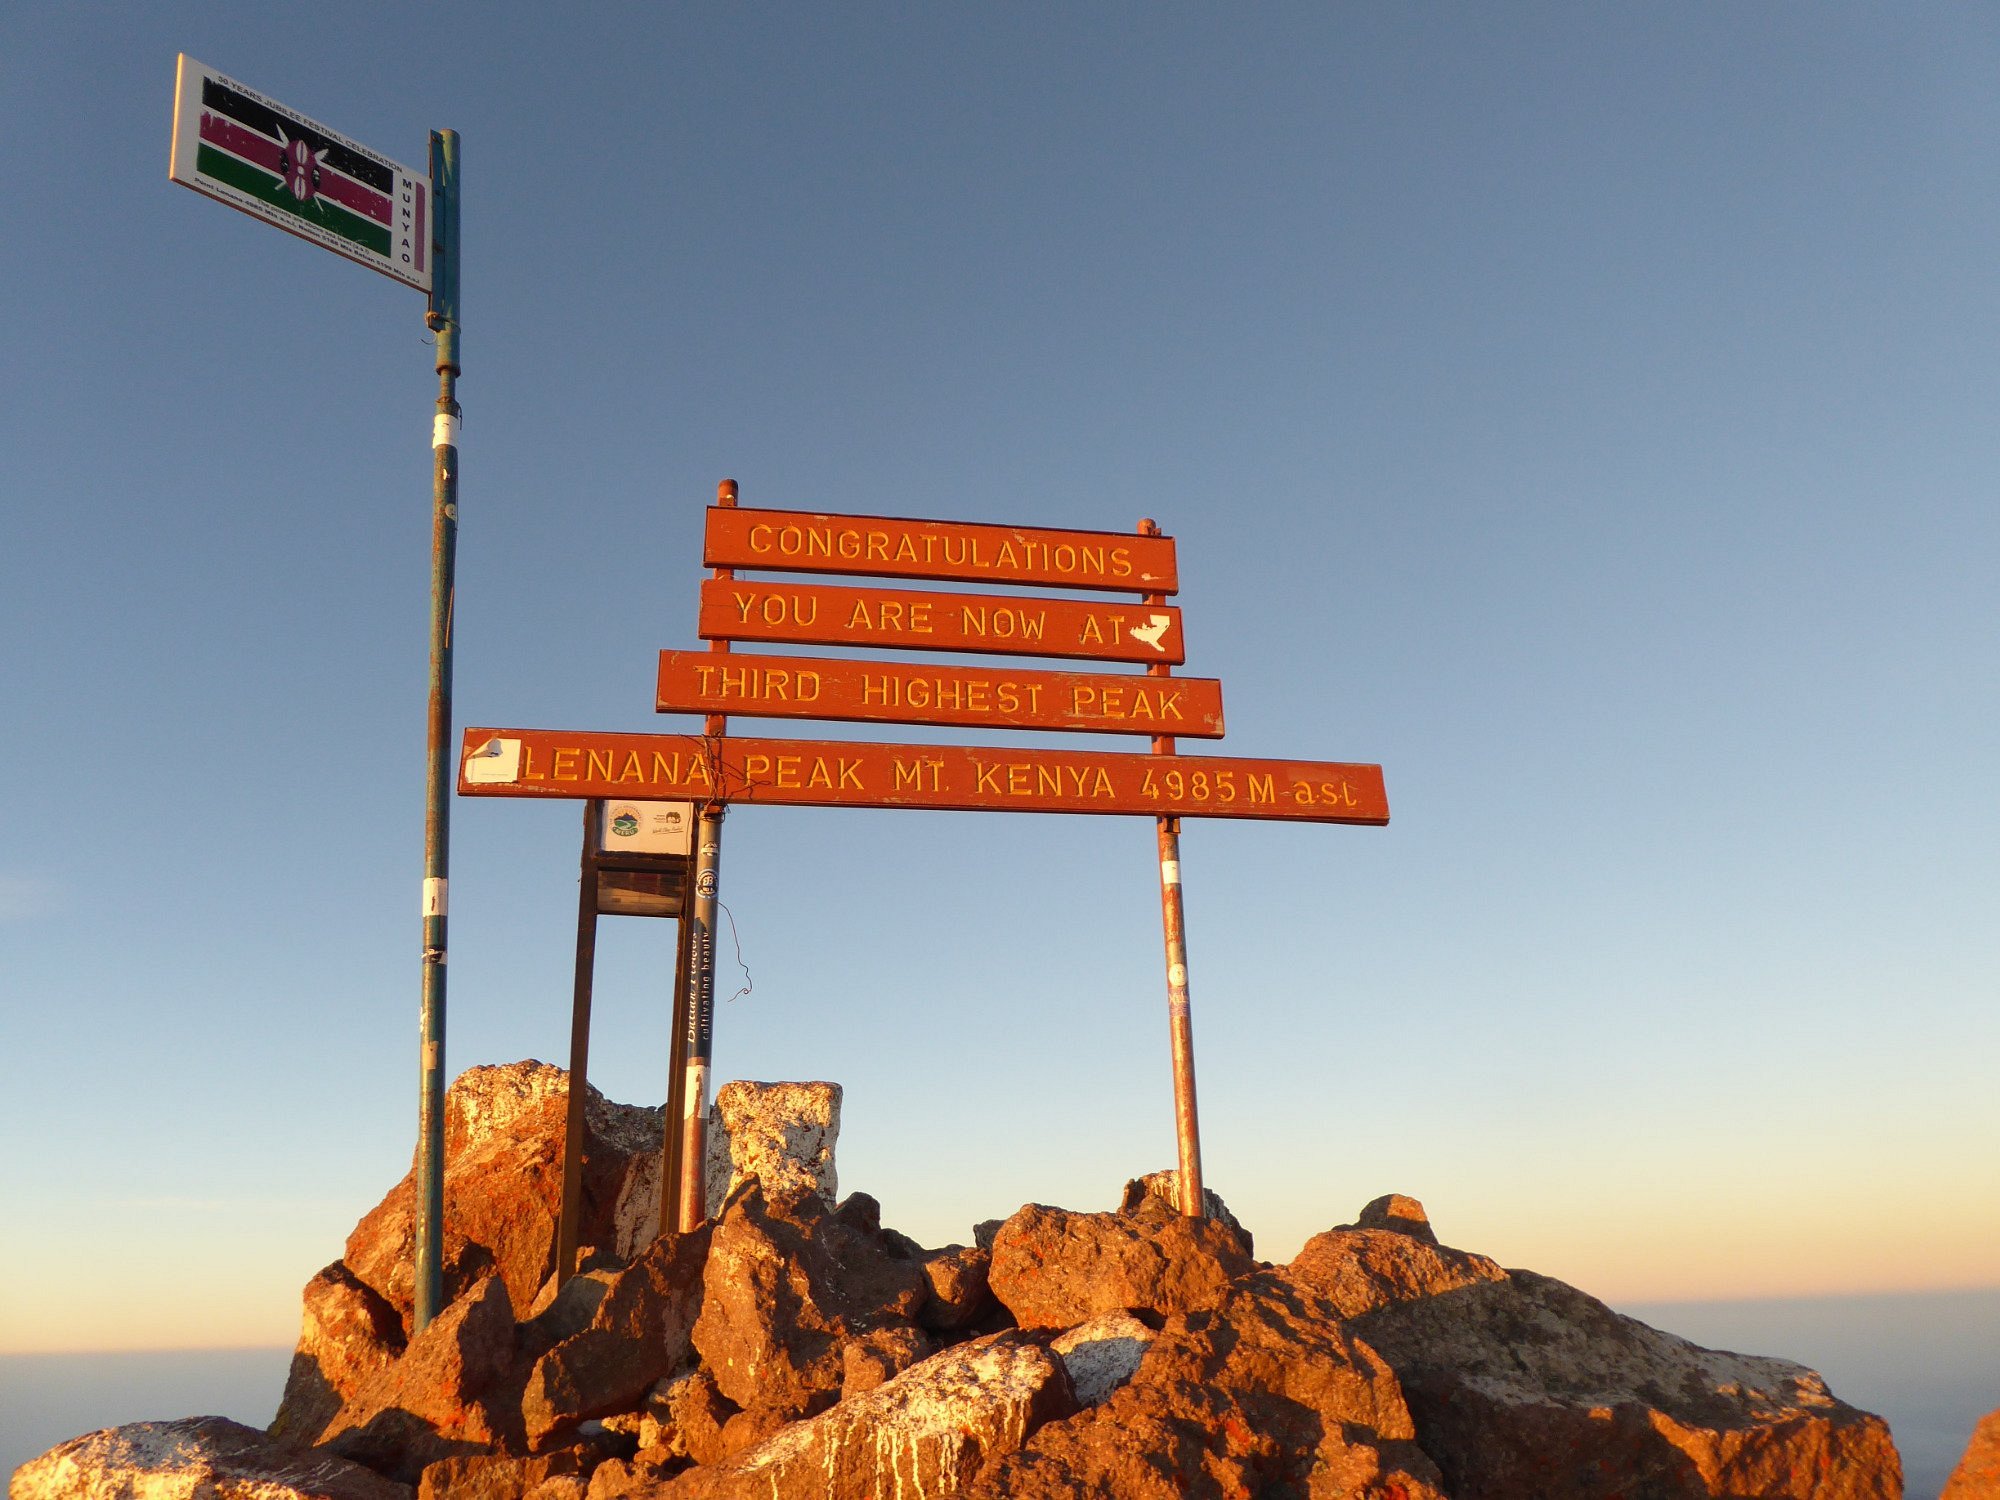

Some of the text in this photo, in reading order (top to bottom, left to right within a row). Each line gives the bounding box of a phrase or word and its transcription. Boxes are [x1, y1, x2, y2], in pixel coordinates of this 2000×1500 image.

[231, 82, 263, 103] YEARS
[264, 99, 301, 121] JUBILEE
[303, 118, 344, 143] FESTIVAL
[345, 140, 403, 173] CELEBRATION
[749, 522, 1133, 579] CONGRATULATIONS
[731, 591, 1125, 645] YOU ARE NOW AT
[695, 664, 1185, 722] THIRD HIGHEST PEAK
[522, 745, 712, 787] LENANA
[744, 753, 864, 792] PEAK
[974, 761, 1116, 799] KENYA
[1139, 767, 1237, 802] 4985
[1247, 771, 1276, 804] M
[701, 932, 711, 1040] cultivating beauty
